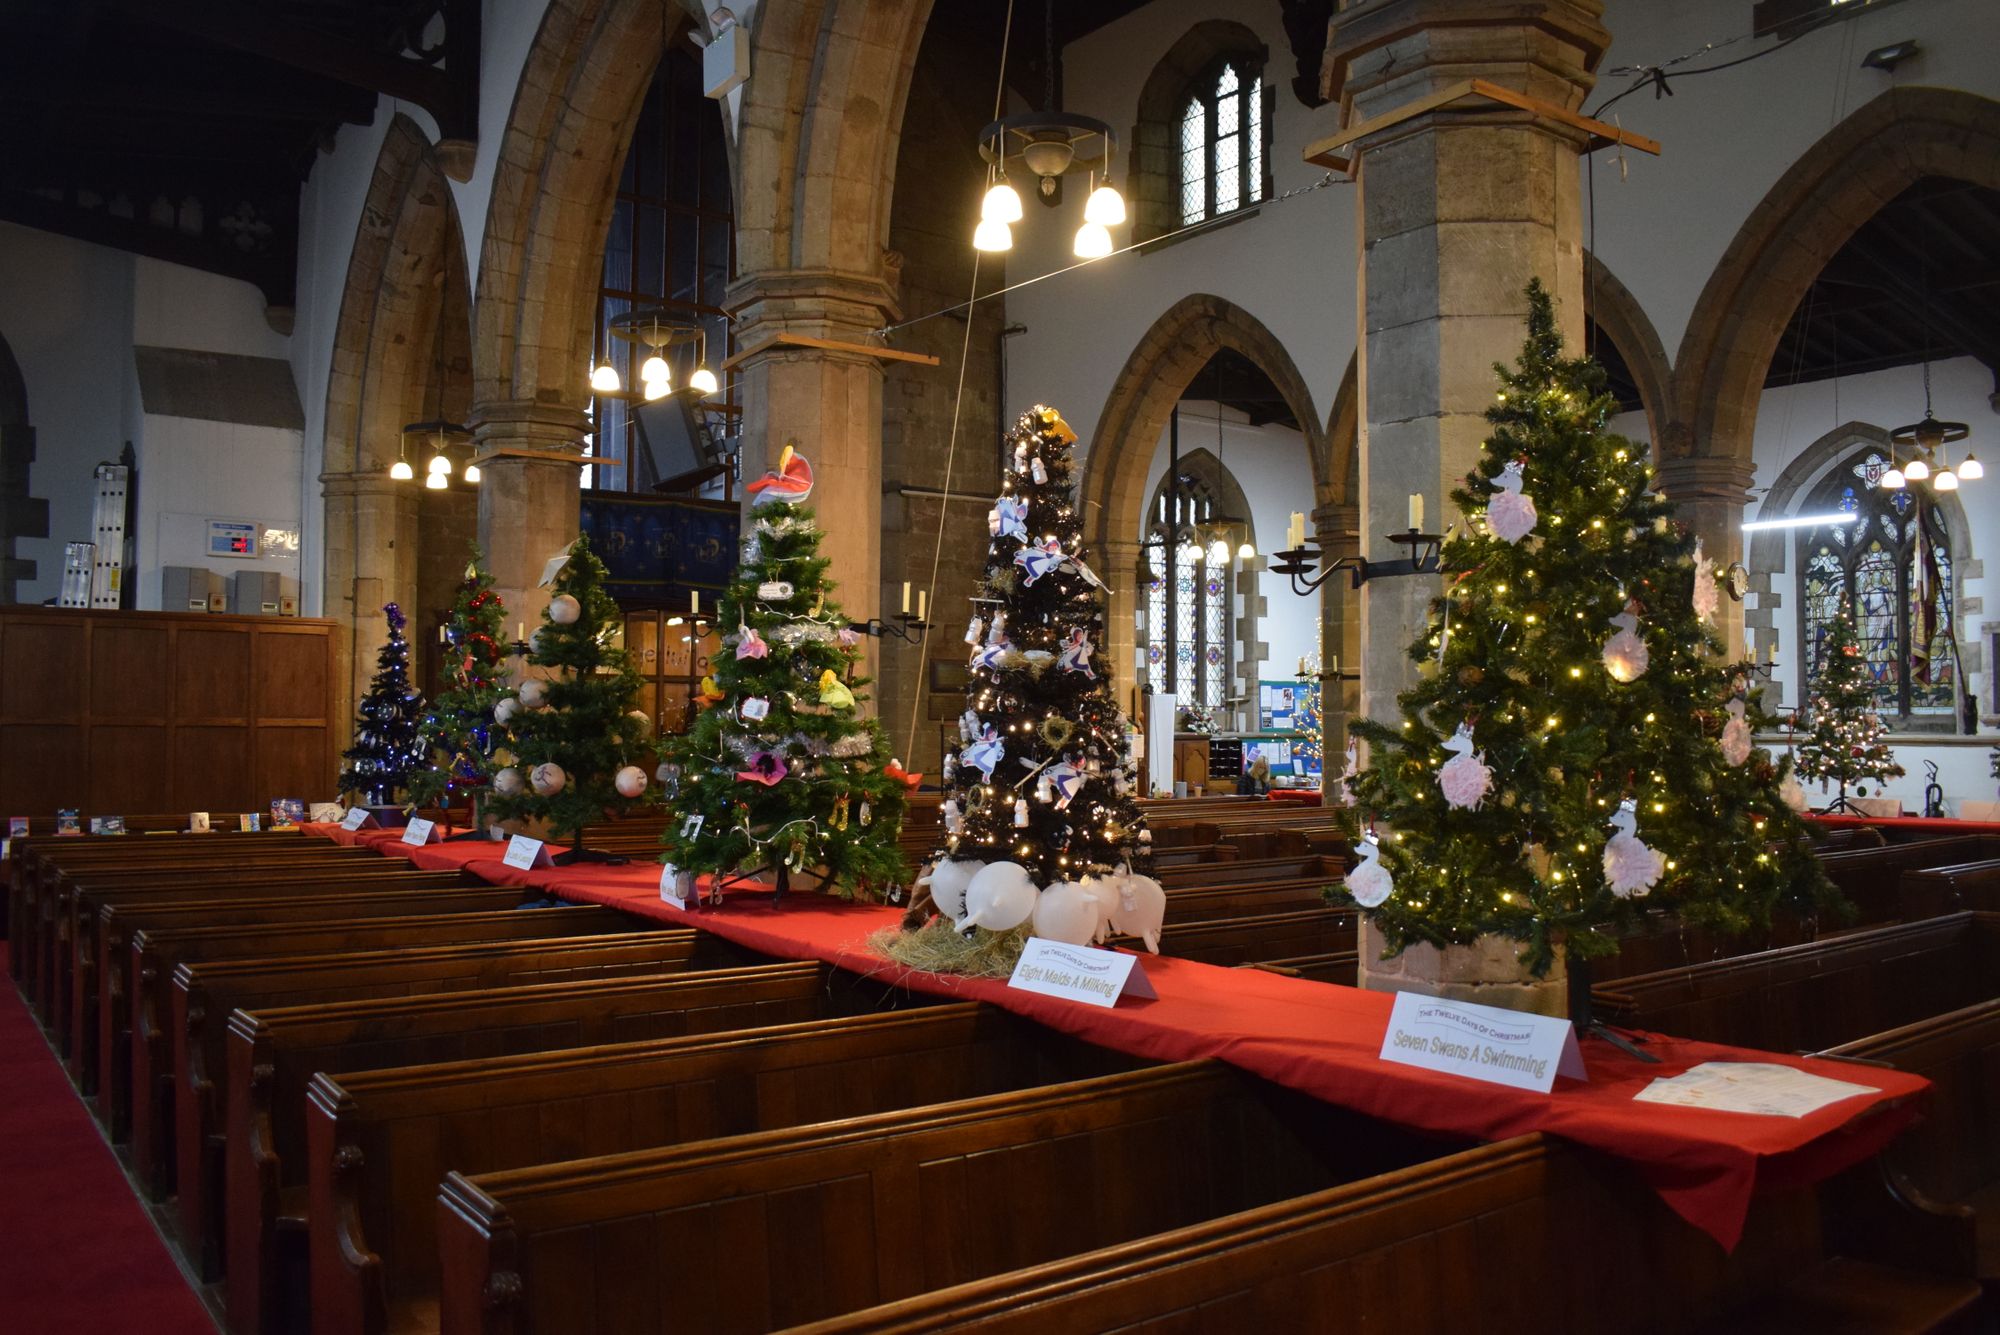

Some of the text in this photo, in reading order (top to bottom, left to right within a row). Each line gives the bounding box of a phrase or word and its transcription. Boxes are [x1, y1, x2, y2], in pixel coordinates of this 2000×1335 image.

[1019, 964, 1116, 998] Eight Maids A Milking
[1433, 1009, 1461, 1023] TWELVE
[1461, 1016, 1479, 1030] DAYS
[1478, 1024, 1490, 1034] OF
[1489, 1028, 1531, 1040] CHRISTMAS
[1393, 1030, 1548, 1079] Seven Swans A Swimming
